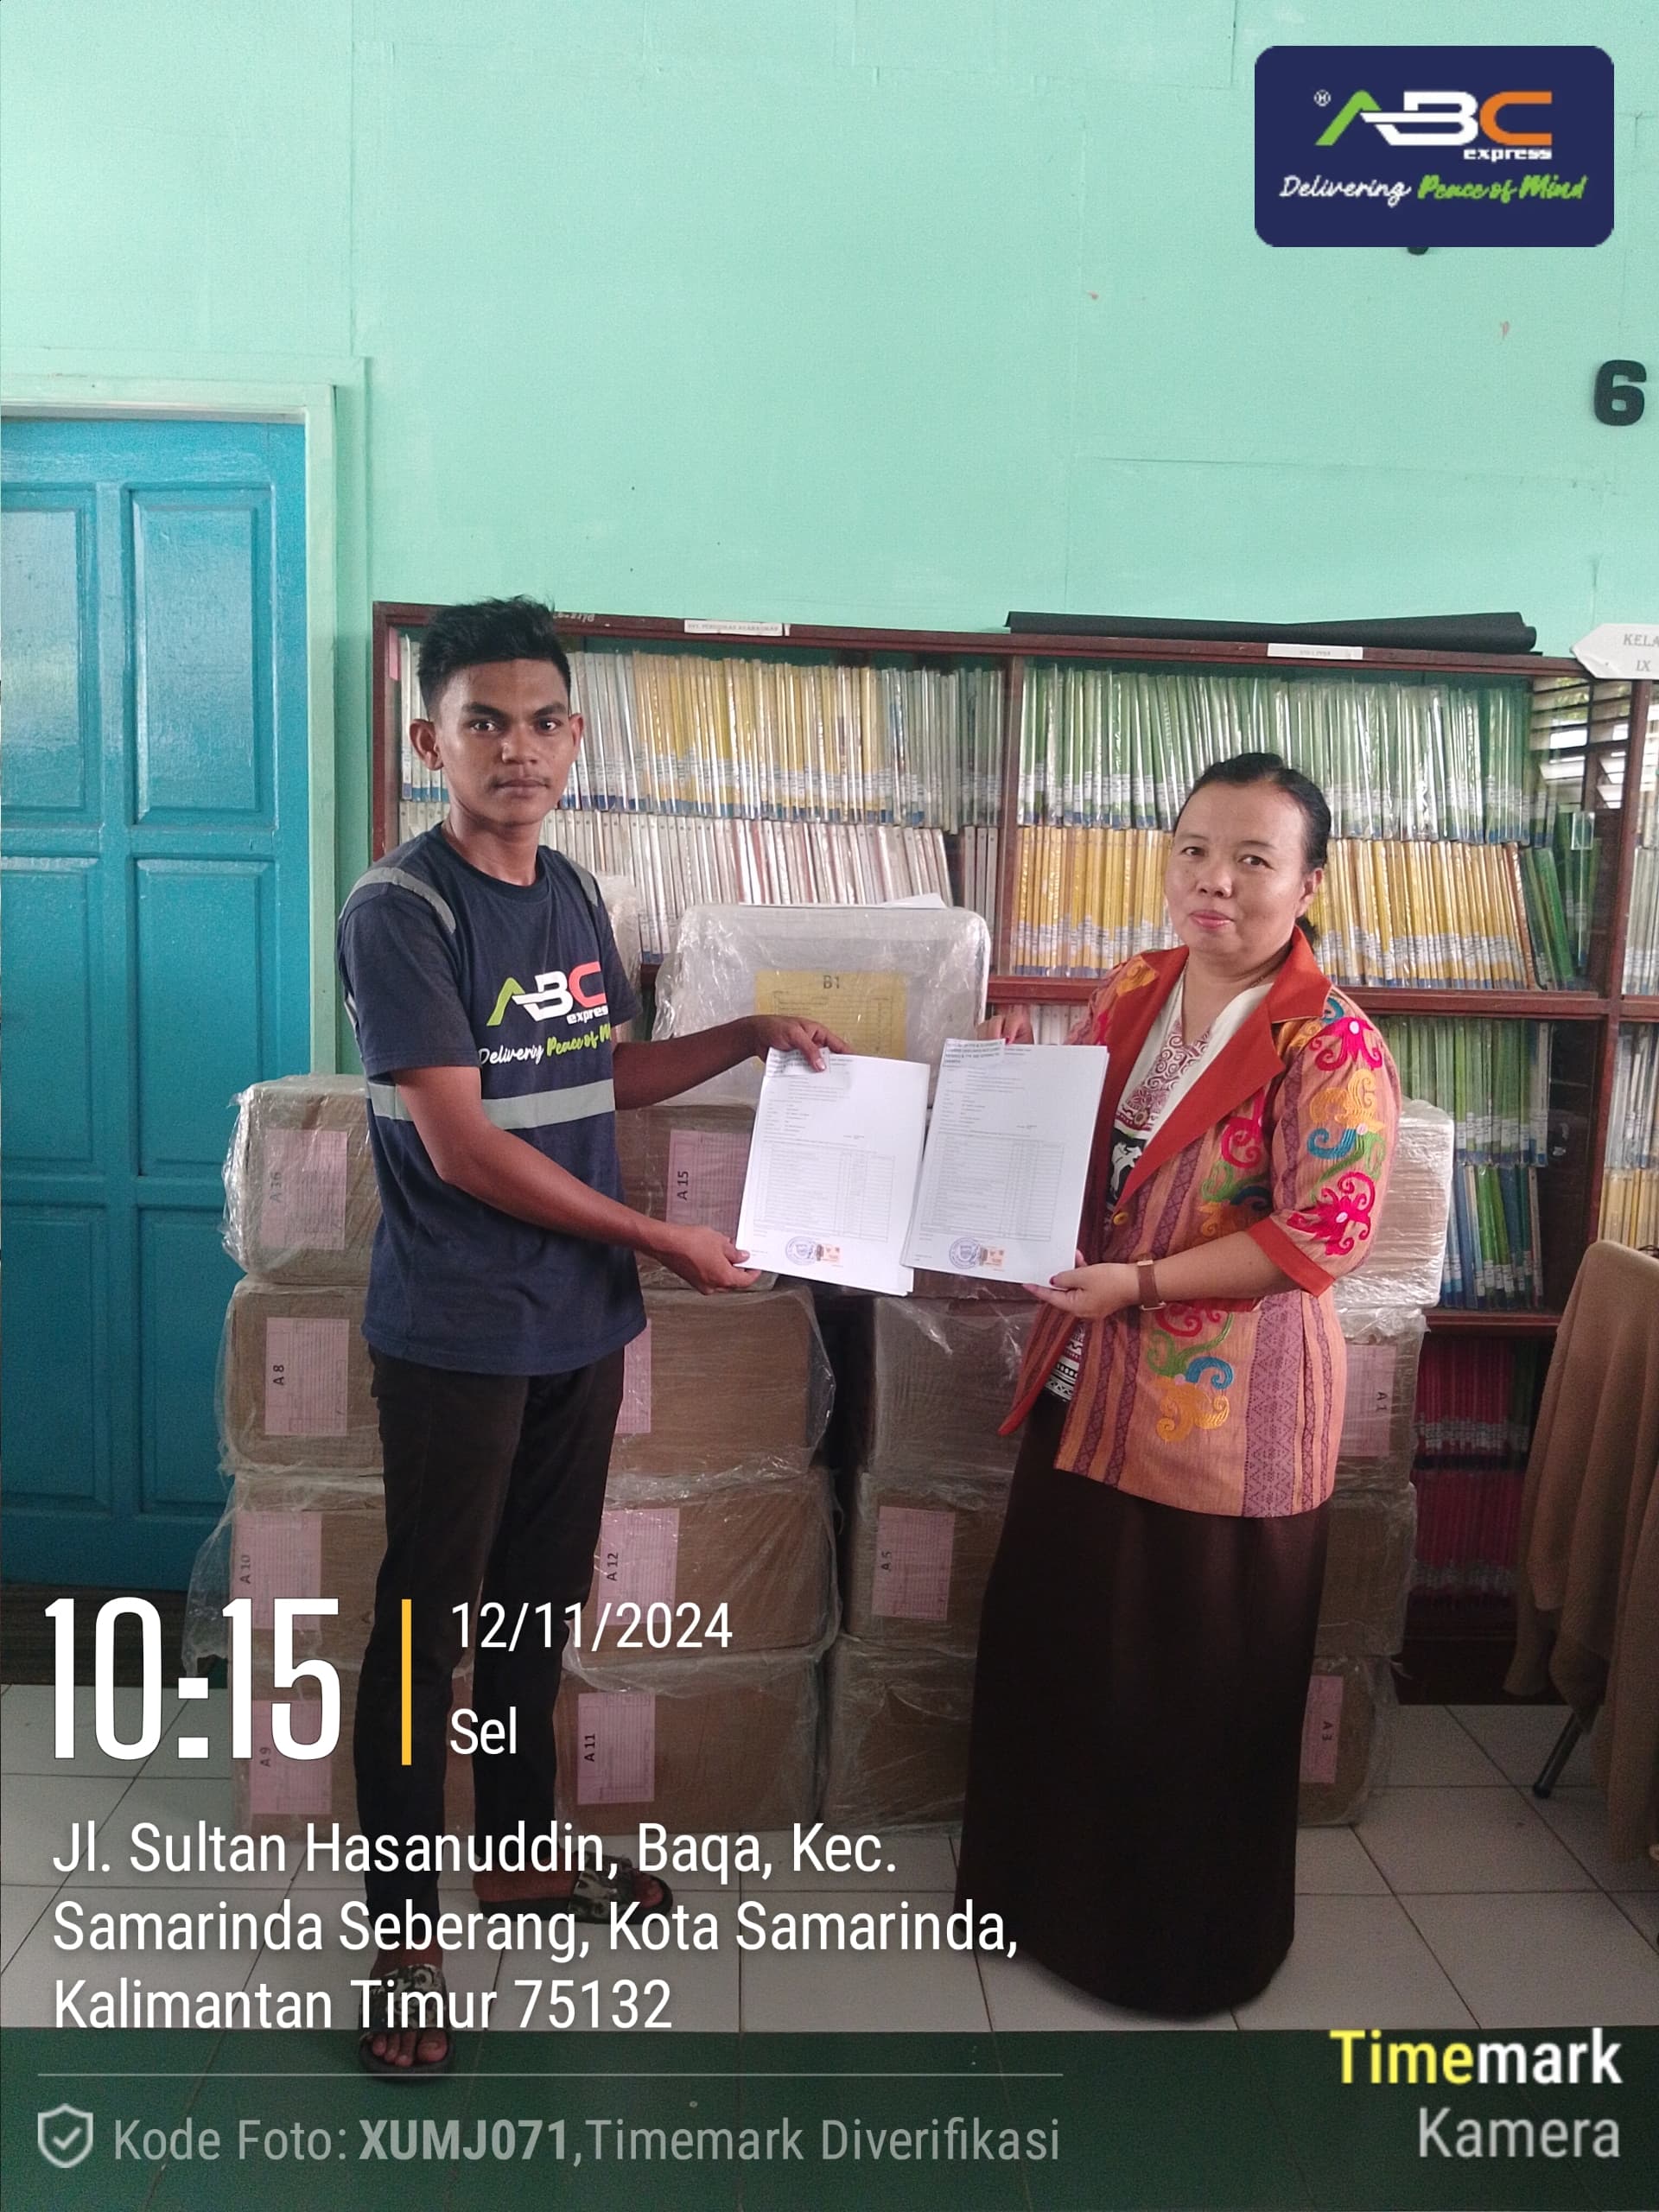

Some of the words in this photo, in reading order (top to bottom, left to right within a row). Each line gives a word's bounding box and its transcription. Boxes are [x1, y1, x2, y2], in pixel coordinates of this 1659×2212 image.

[1594, 359, 1647, 427] 6
[1637, 659, 1651, 672] IX
[823, 975, 841, 989] B1
[486, 961, 607, 1027] ABC
[583, 1030, 599, 1049] of
